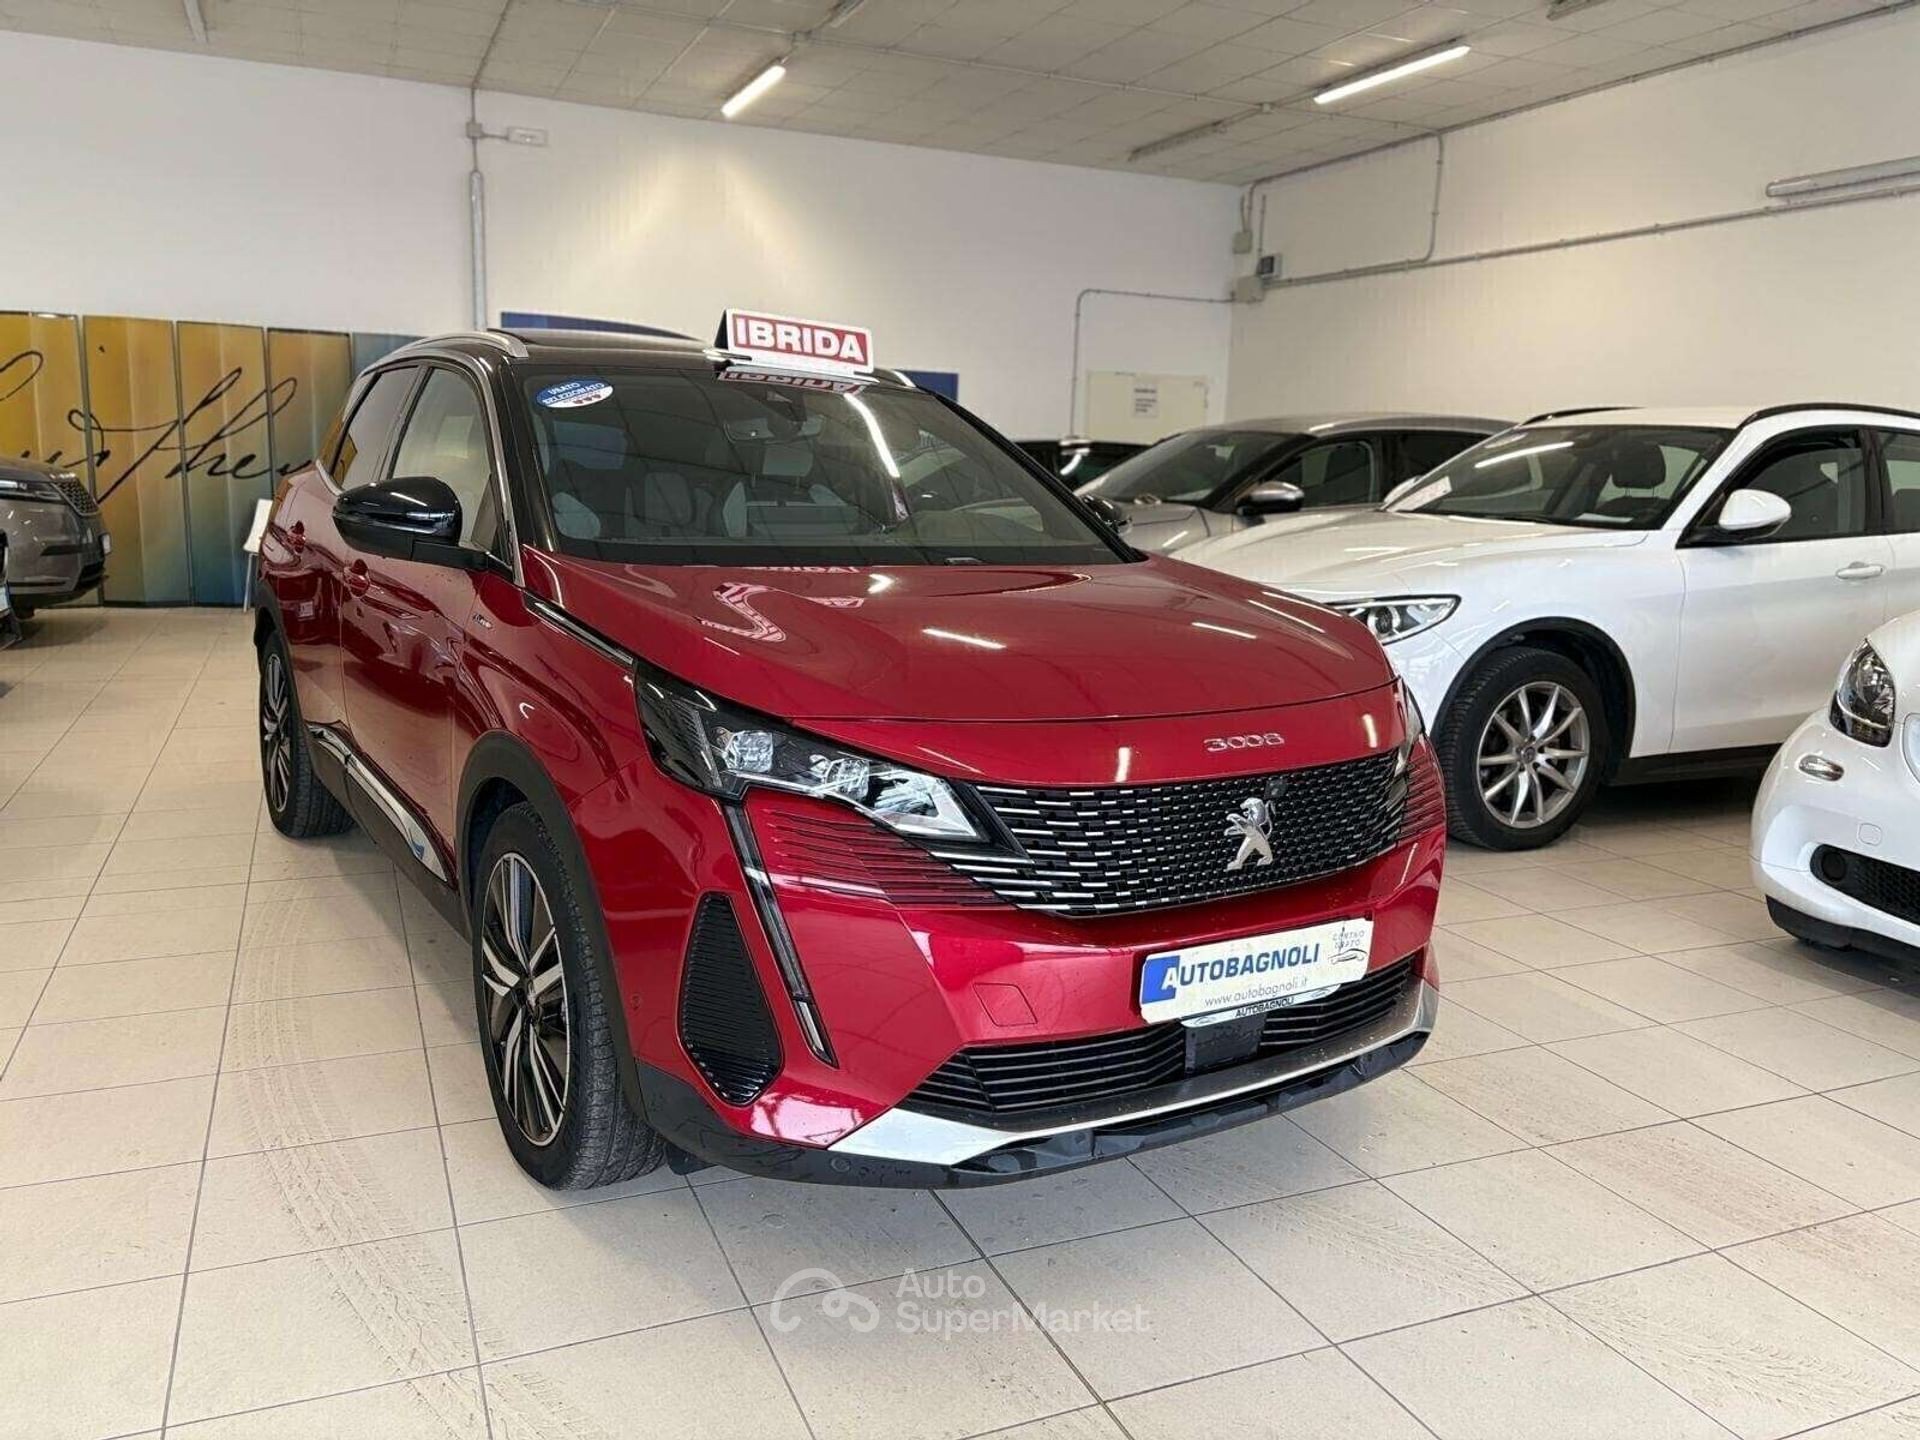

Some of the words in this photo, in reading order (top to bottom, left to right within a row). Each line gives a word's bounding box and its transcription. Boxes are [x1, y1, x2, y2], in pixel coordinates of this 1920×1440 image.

[735, 317, 865, 363] IBRIDA
[1203, 733, 1285, 752] 3008
[1161, 943, 1320, 991] AUTOBAGNOLI
[1204, 975, 1309, 1006] www.autobagnoli.it
